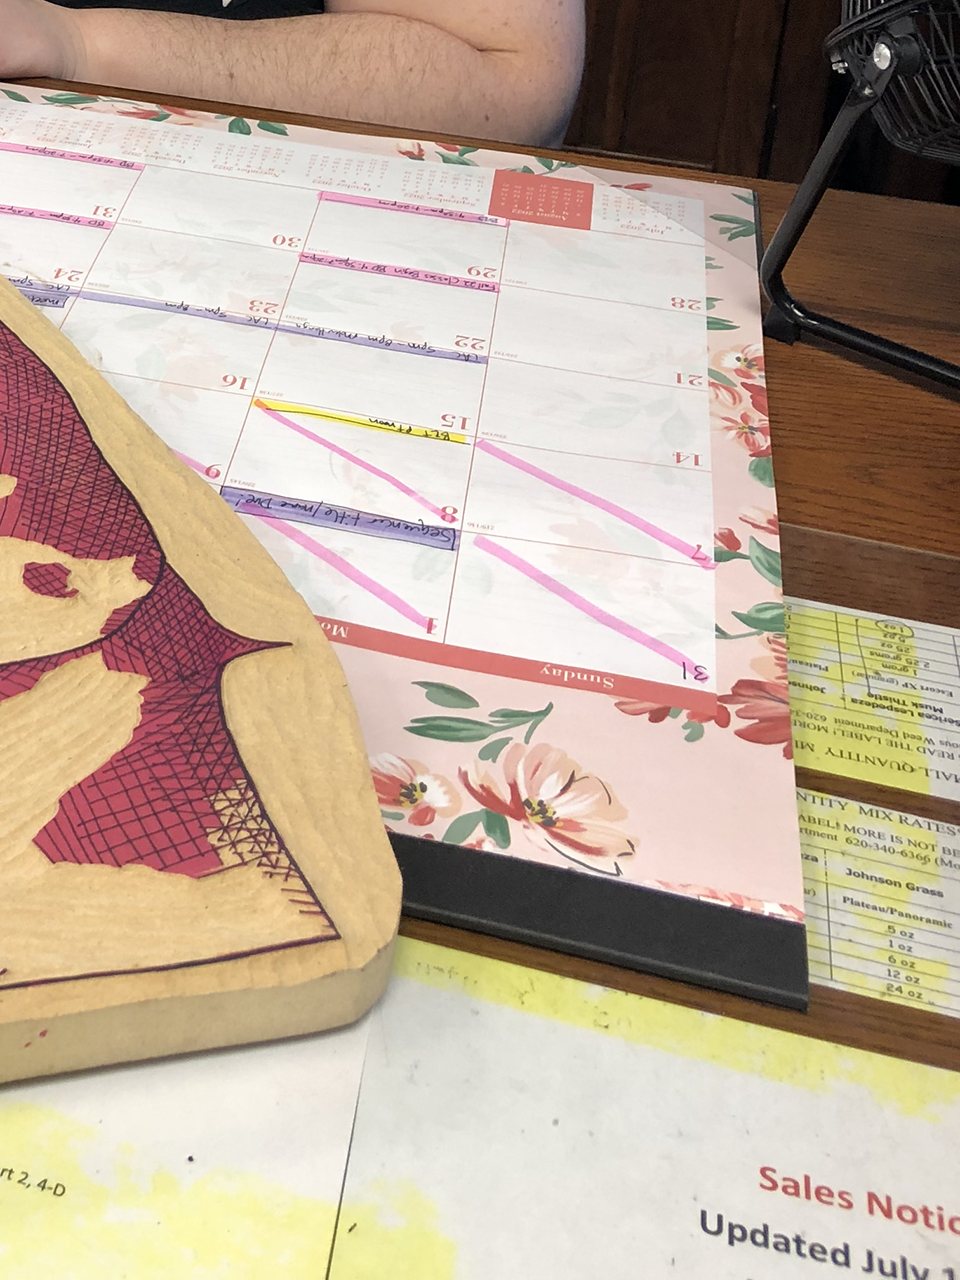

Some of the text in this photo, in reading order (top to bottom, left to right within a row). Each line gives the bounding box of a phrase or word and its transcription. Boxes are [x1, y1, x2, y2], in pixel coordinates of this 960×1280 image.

[336, 182, 372, 192] October
[92, 204, 117, 218] 31
[536, 212, 568, 222] August
[645, 227, 664, 235] July
[272, 234, 302, 248] 30
[53, 268, 83, 283] 24
[466, 264, 497, 279] 29
[248, 300, 280, 316] 23
[670, 296, 702, 312] 28
[408, 342, 436, 354] 5pm
[454, 334, 486, 350] 22
[222, 374, 250, 390] 16
[674, 372, 704, 386] 21
[440, 414, 471, 430] 15
[672, 452, 703, 466] 14
[206, 464, 222, 480] 9
[440, 506, 458, 524] 8
[691, 544, 708, 561] 7
[426, 618, 438, 636] 1
[869, 650, 902, 662] grams
[682, 662, 709, 682] 31
[881, 662, 910, 674] gram
[538, 664, 615, 689] Sunday
[902, 681, 918, 690] XP
[920, 684, 954, 698] Escort
[850, 698, 915, 717] Lespedeza
[866, 692, 944, 714] Musk Thistle
[834, 717, 899, 738] Department
[832, 728, 882, 746] LABEL!
[903, 730, 936, 746] Weed
[884, 738, 913, 753] THE
[916, 745, 955, 761] READ
[824, 746, 914, 774] QUANTITY
[858, 804, 894, 822] MIX
[843, 823, 938, 853] MORE IS NOT
[844, 836, 931, 865] 620-340-6366
[846, 868, 944, 898] Johnson Grass
[842, 896, 954, 930] Plateau/Panoramic
[899, 930, 916, 939] oz
[888, 939, 914, 953] 1 oz
[888, 954, 916, 968] 6 oz
[886, 968, 921, 985] 12 oz
[886, 983, 924, 1000] 24 oz
[36, 1178, 66, 1198] 4-D
[759, 1166, 854, 1210] Sales
[700, 1208, 930, 1280] Updated July
